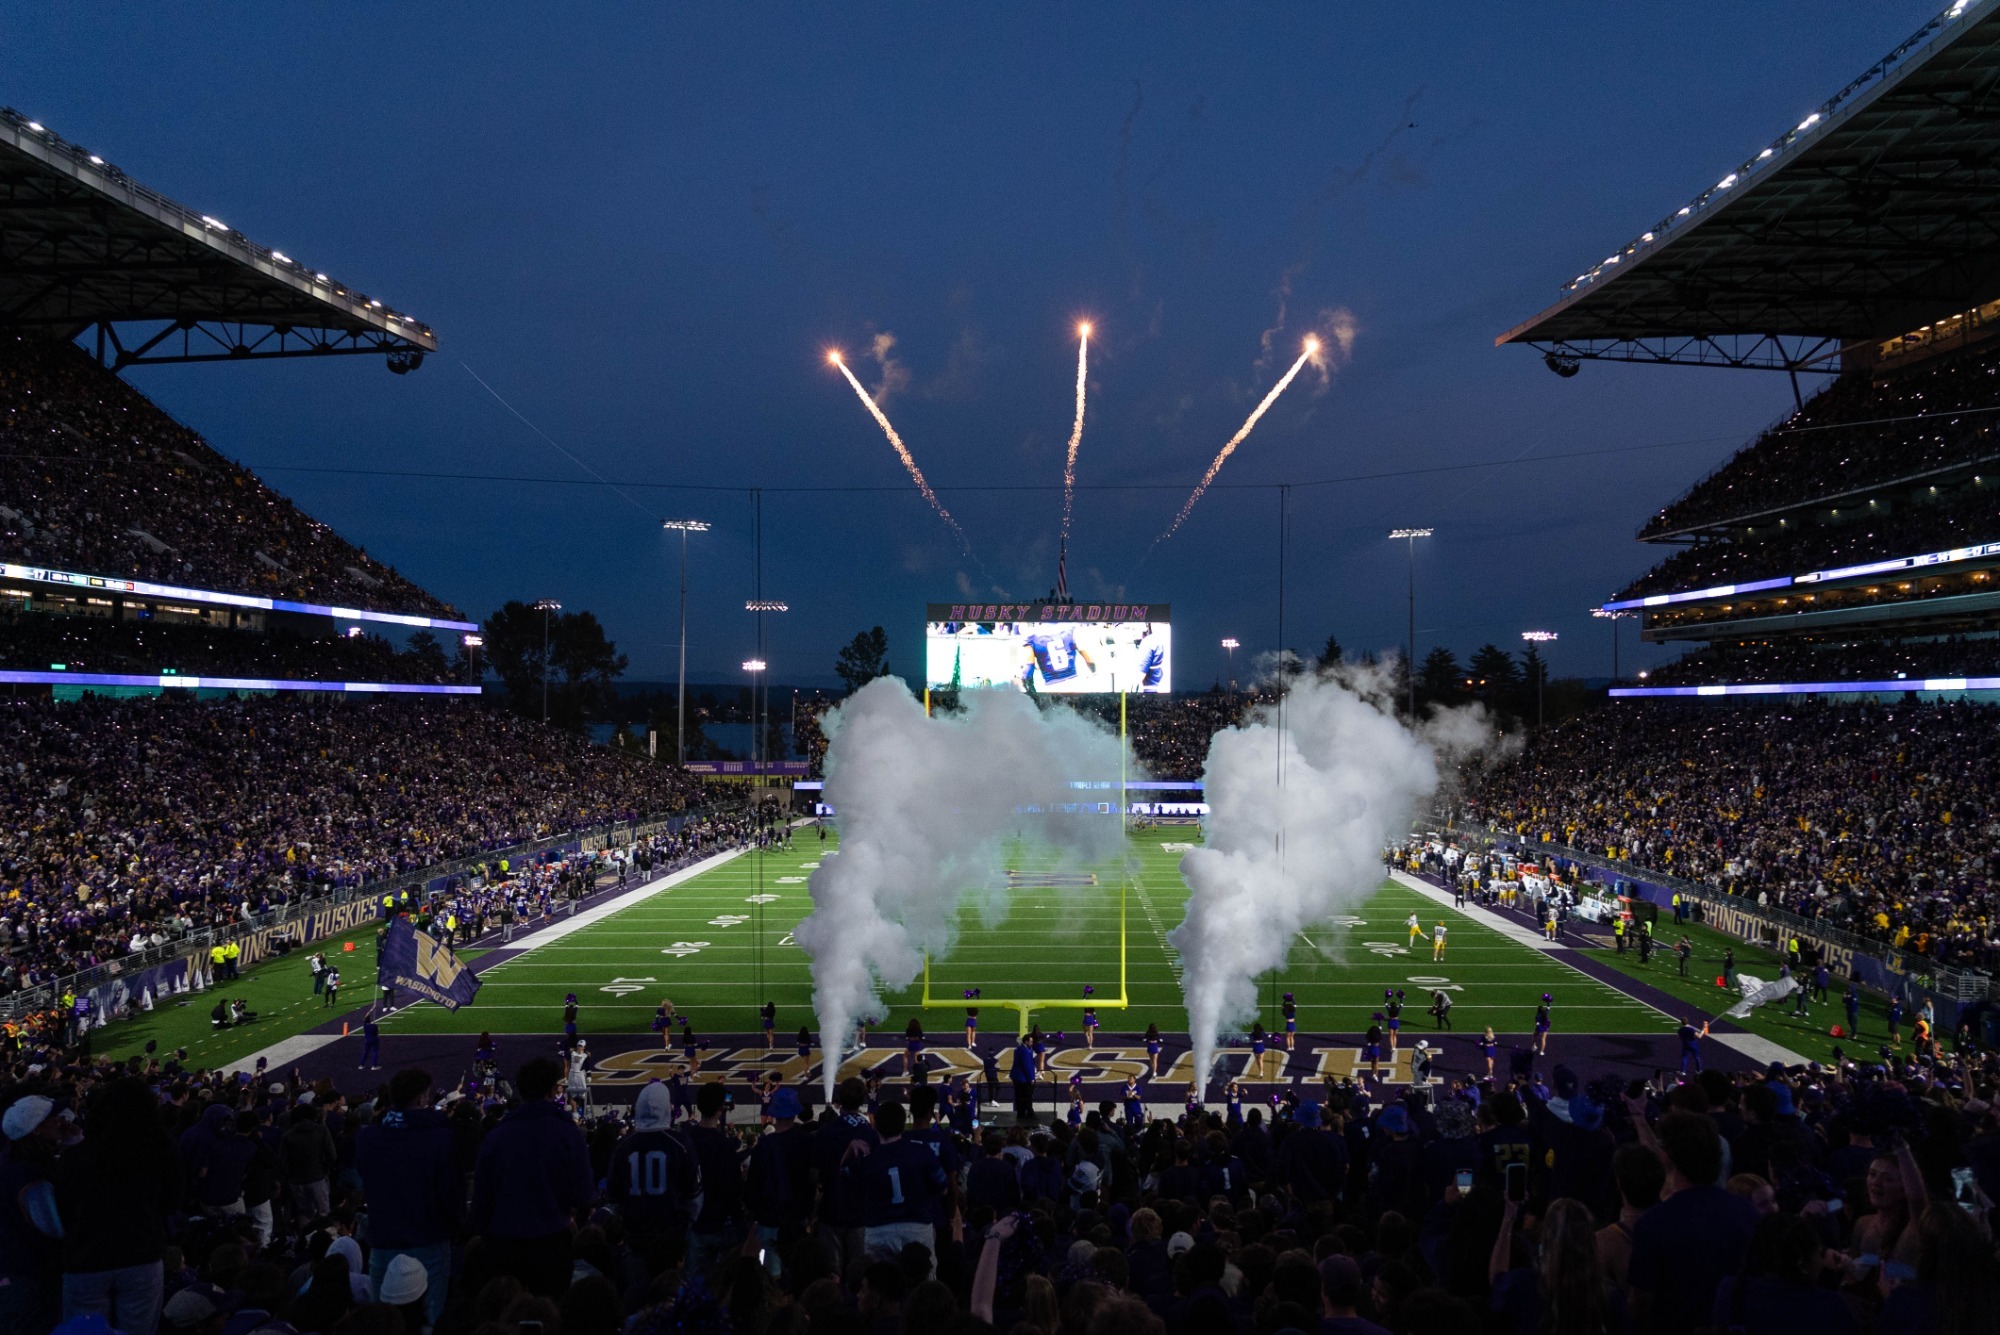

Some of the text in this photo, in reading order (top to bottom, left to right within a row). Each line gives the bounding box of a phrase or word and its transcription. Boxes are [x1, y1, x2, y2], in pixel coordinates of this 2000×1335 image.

[949, 606, 1148, 620] HUSKY STADIUM
[1046, 639, 1068, 672] 6
[311, 896, 378, 941] HUSKIES
[412, 929, 467, 989] W
[660, 941, 711, 955] 20
[1361, 941, 1411, 955] 20
[599, 977, 658, 992] 10
[1406, 976, 1465, 992] 10
[628, 1150, 668, 1196] 10
[1222, 1167, 1231, 1190] 1
[888, 1166, 905, 1204] 1
